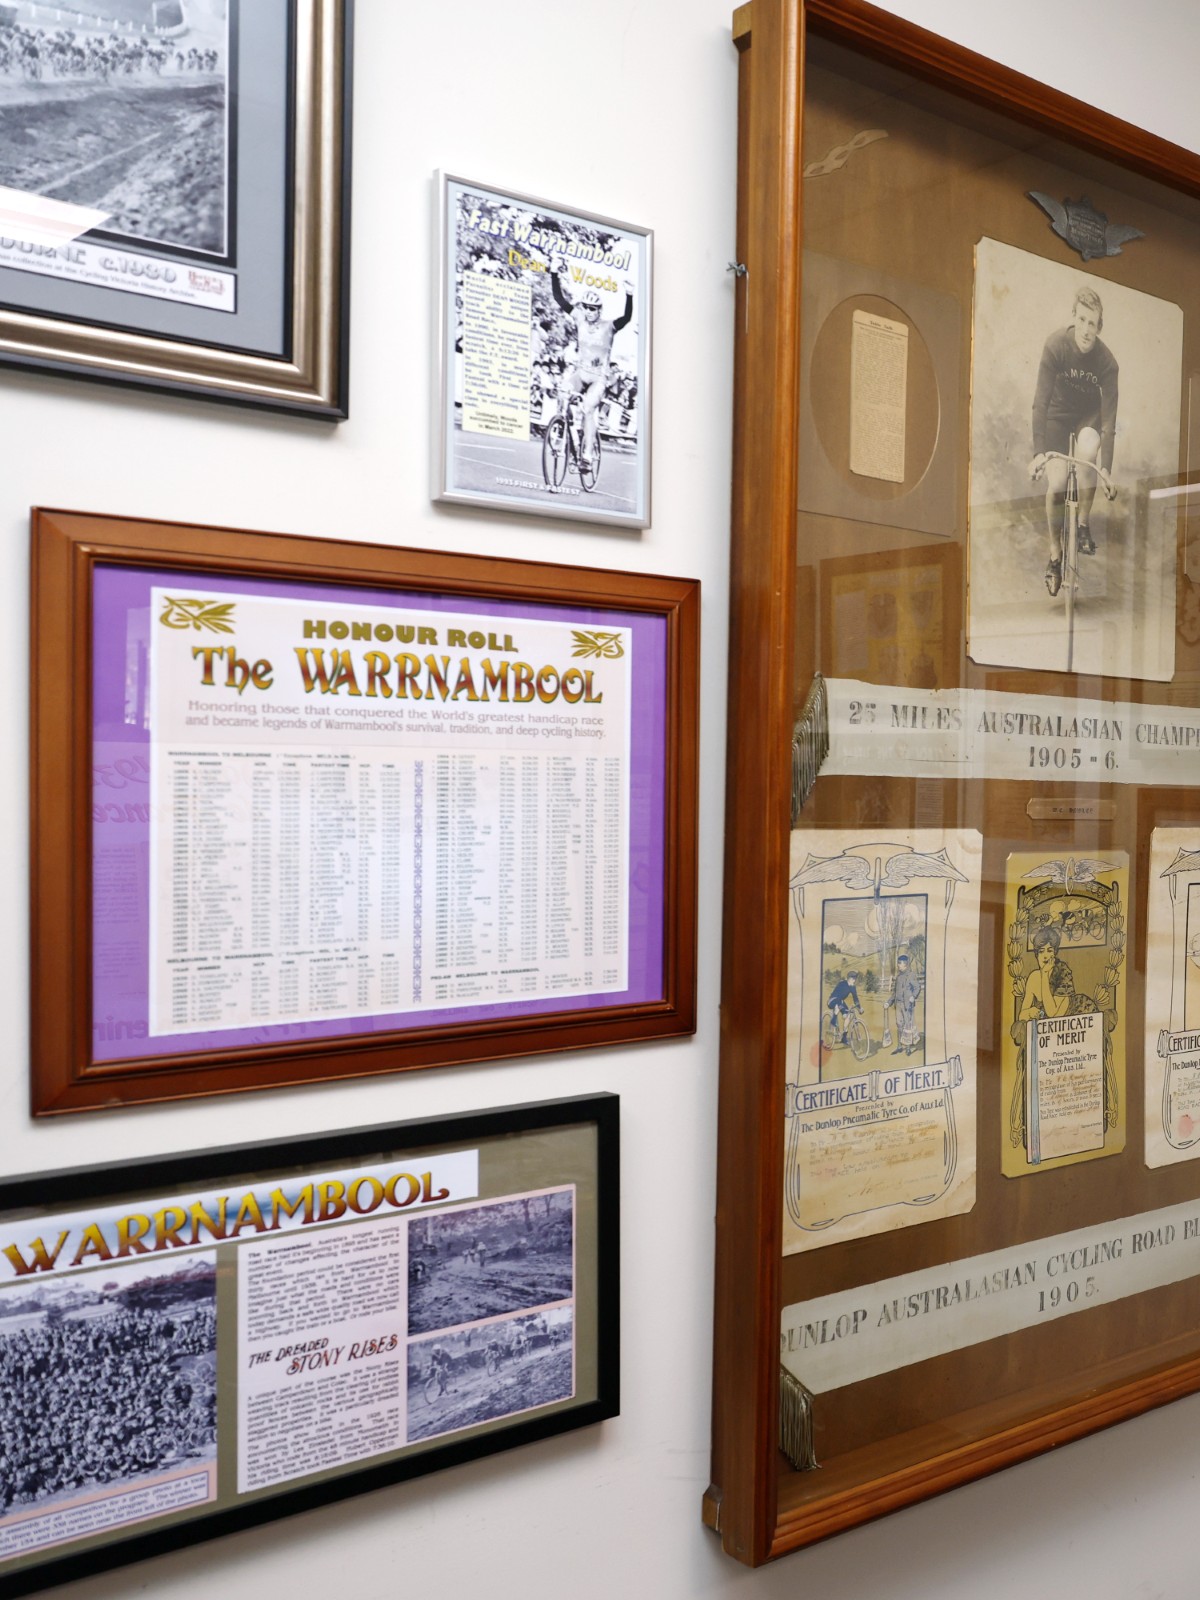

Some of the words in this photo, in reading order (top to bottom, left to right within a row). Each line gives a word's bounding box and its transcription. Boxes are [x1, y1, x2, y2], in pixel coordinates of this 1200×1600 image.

[468, 209, 510, 238] Fast
[513, 221, 632, 271] Warrnambool
[508, 249, 546, 273] Dean
[570, 265, 619, 293] Woods
[302, 619, 439, 647] HONOUR
[447, 628, 519, 653] ROLL
[192, 645, 274, 696] The
[293, 646, 604, 704] WARRNAMBOOL
[186, 715, 209, 727] and
[213, 716, 259, 728] became
[263, 717, 307, 730] legends
[310, 718, 322, 729] of
[406, 722, 447, 734] survival,
[450, 724, 494, 735] tradition,
[496, 725, 514, 734] and
[516, 726, 539, 738] deep
[541, 726, 573, 738] cycling
[575, 728, 607, 739] history.
[188, 700, 257, 715] Honoring
[262, 703, 300, 715] those
[304, 705, 331, 716] that
[335, 706, 403, 722] conquered
[408, 709, 428, 719] the
[431, 710, 474, 721] World's
[478, 713, 525, 726] greatest
[528, 714, 578, 727] handicap
[581, 717, 604, 726] race
[891, 704, 962, 731] MILES
[977, 712, 1123, 743] AUSTRALASIAN
[1029, 746, 1082, 769] 1905
[1037, 1016, 1094, 1035] CERTIFICATE
[1039, 1035, 1051, 1048] OF
[1056, 1031, 1087, 1047] MERIT
[795, 1083, 868, 1112] CERTIFICATE
[884, 1076, 901, 1094] OF
[904, 1070, 945, 1092] MERIT.
[801, 1122, 814, 1133] The
[815, 1117, 841, 1132] Dunlop
[843, 1111, 880, 1127] Pneumatic
[881, 1108, 898, 1119] Tyre
[910, 1102, 918, 1112] of
[2, 1171, 450, 1277] WARRNAMBOOL
[877, 1260, 1037, 1327] AUSTRALASIAN
[1046, 1238, 1123, 1278] CYCLING
[1131, 1224, 1176, 1255] ROAD
[1038, 1276, 1099, 1313] 1905.
[248, 1350, 272, 1369] THE
[275, 1337, 330, 1362] DREADED
[286, 1346, 345, 1376] STONY
[348, 1334, 398, 1362] RISES
